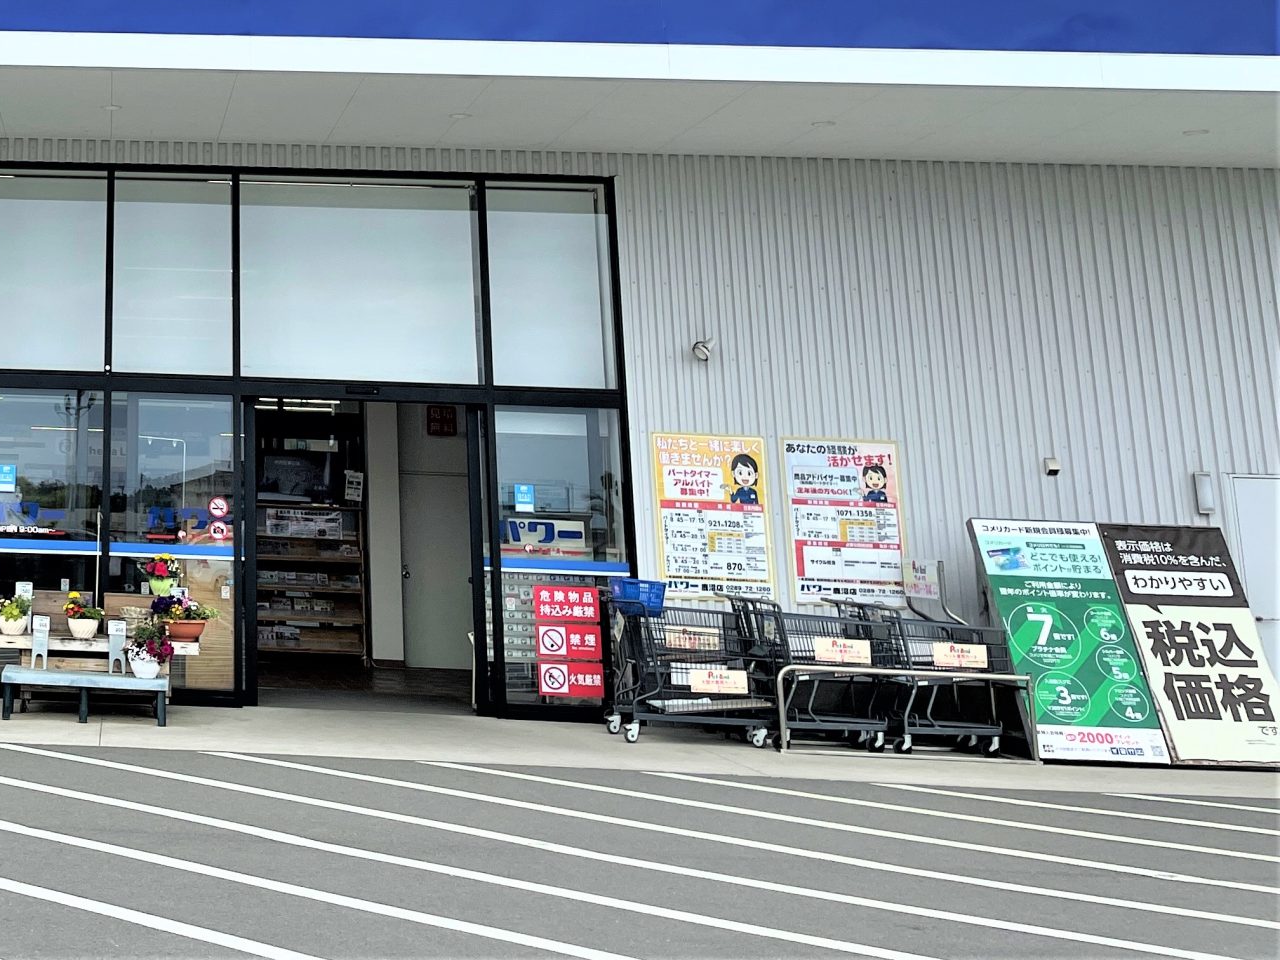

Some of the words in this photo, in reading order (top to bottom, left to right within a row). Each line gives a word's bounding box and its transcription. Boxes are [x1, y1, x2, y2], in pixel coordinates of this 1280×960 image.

[656, 437, 760, 453] 私たちと一緒に楽しく
[785, 444, 858, 456] あなたの経験が
[659, 451, 733, 467] 働きませんか?
[827, 454, 893, 467] 活かせます!
[668, 468, 718, 478] パートタイマー
[794, 472, 858, 483] 商品アドバイザー募集中
[673, 479, 713, 487] アルバイト
[679, 488, 710, 497] 募集中!
[1115, 540, 1173, 552] 表示価格は
[1030, 552, 1102, 564] どこでも使える!
[668, 581, 699, 589] パワー
[800, 584, 832, 592] パワー
[1131, 575, 1226, 591] わかりやすい
[540, 590, 594, 603] 危険物品
[540, 604, 595, 617] 持込み厳禁
[1026, 613, 1054, 645] 7
[569, 633, 596, 646] 禁煙
[1141, 620, 1259, 668] 税込
[569, 673, 602, 687] 火気厳禁
[1162, 672, 1276, 722] 価格
[1078, 731, 1114, 744] 2000
